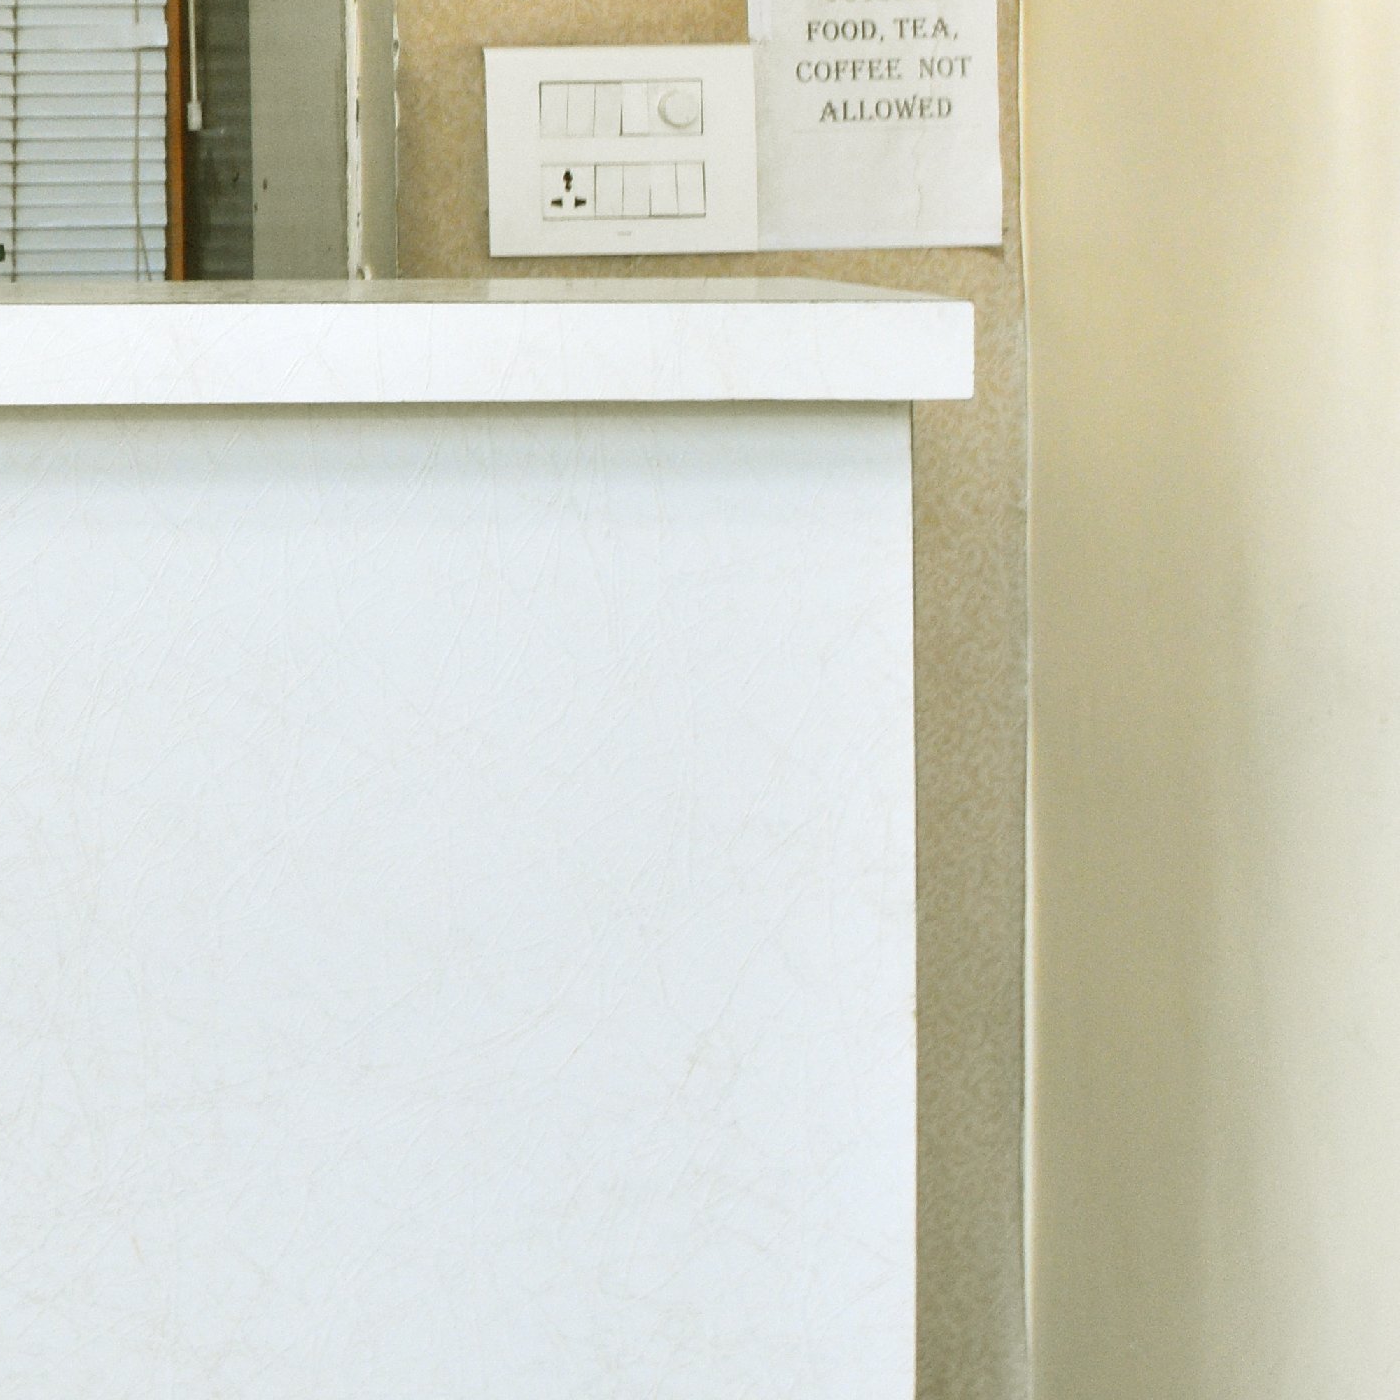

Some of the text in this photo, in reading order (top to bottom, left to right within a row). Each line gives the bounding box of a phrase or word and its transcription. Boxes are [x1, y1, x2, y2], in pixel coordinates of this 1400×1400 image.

[806, 17, 960, 42] FOOD, TEA,
[795, 56, 972, 82] COFFEE NOT
[819, 96, 952, 122] ALLOWED
